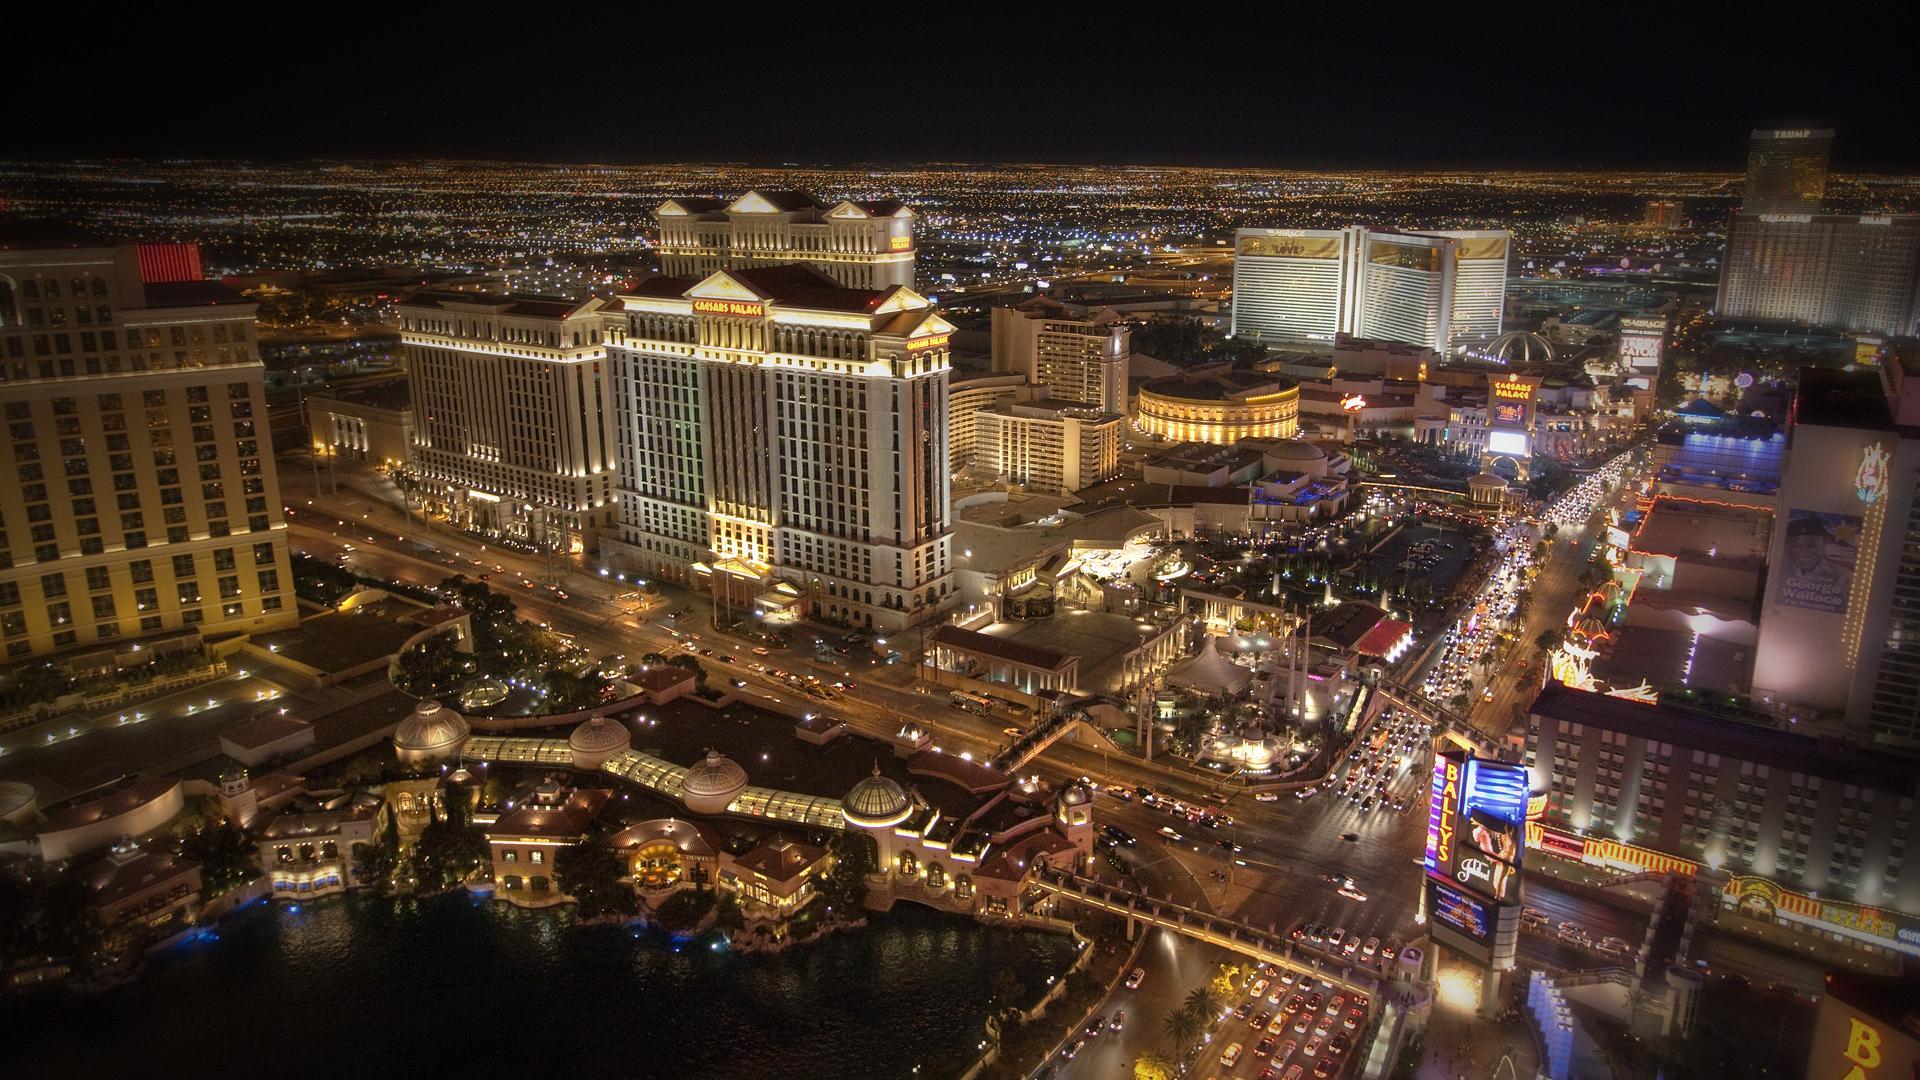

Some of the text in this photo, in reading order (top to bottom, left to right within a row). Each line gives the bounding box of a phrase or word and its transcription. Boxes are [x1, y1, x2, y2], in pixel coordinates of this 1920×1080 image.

[1774, 130, 1810, 139] TRUMP
[695, 301, 762, 315] CAESARS PALACE
[1494, 381, 1532, 392] CAESARS
[1496, 389, 1529, 399] PALACE
[1786, 577, 1842, 595] George
[1783, 588, 1842, 605] Wallace
[1843, 1017, 1882, 1080] B
